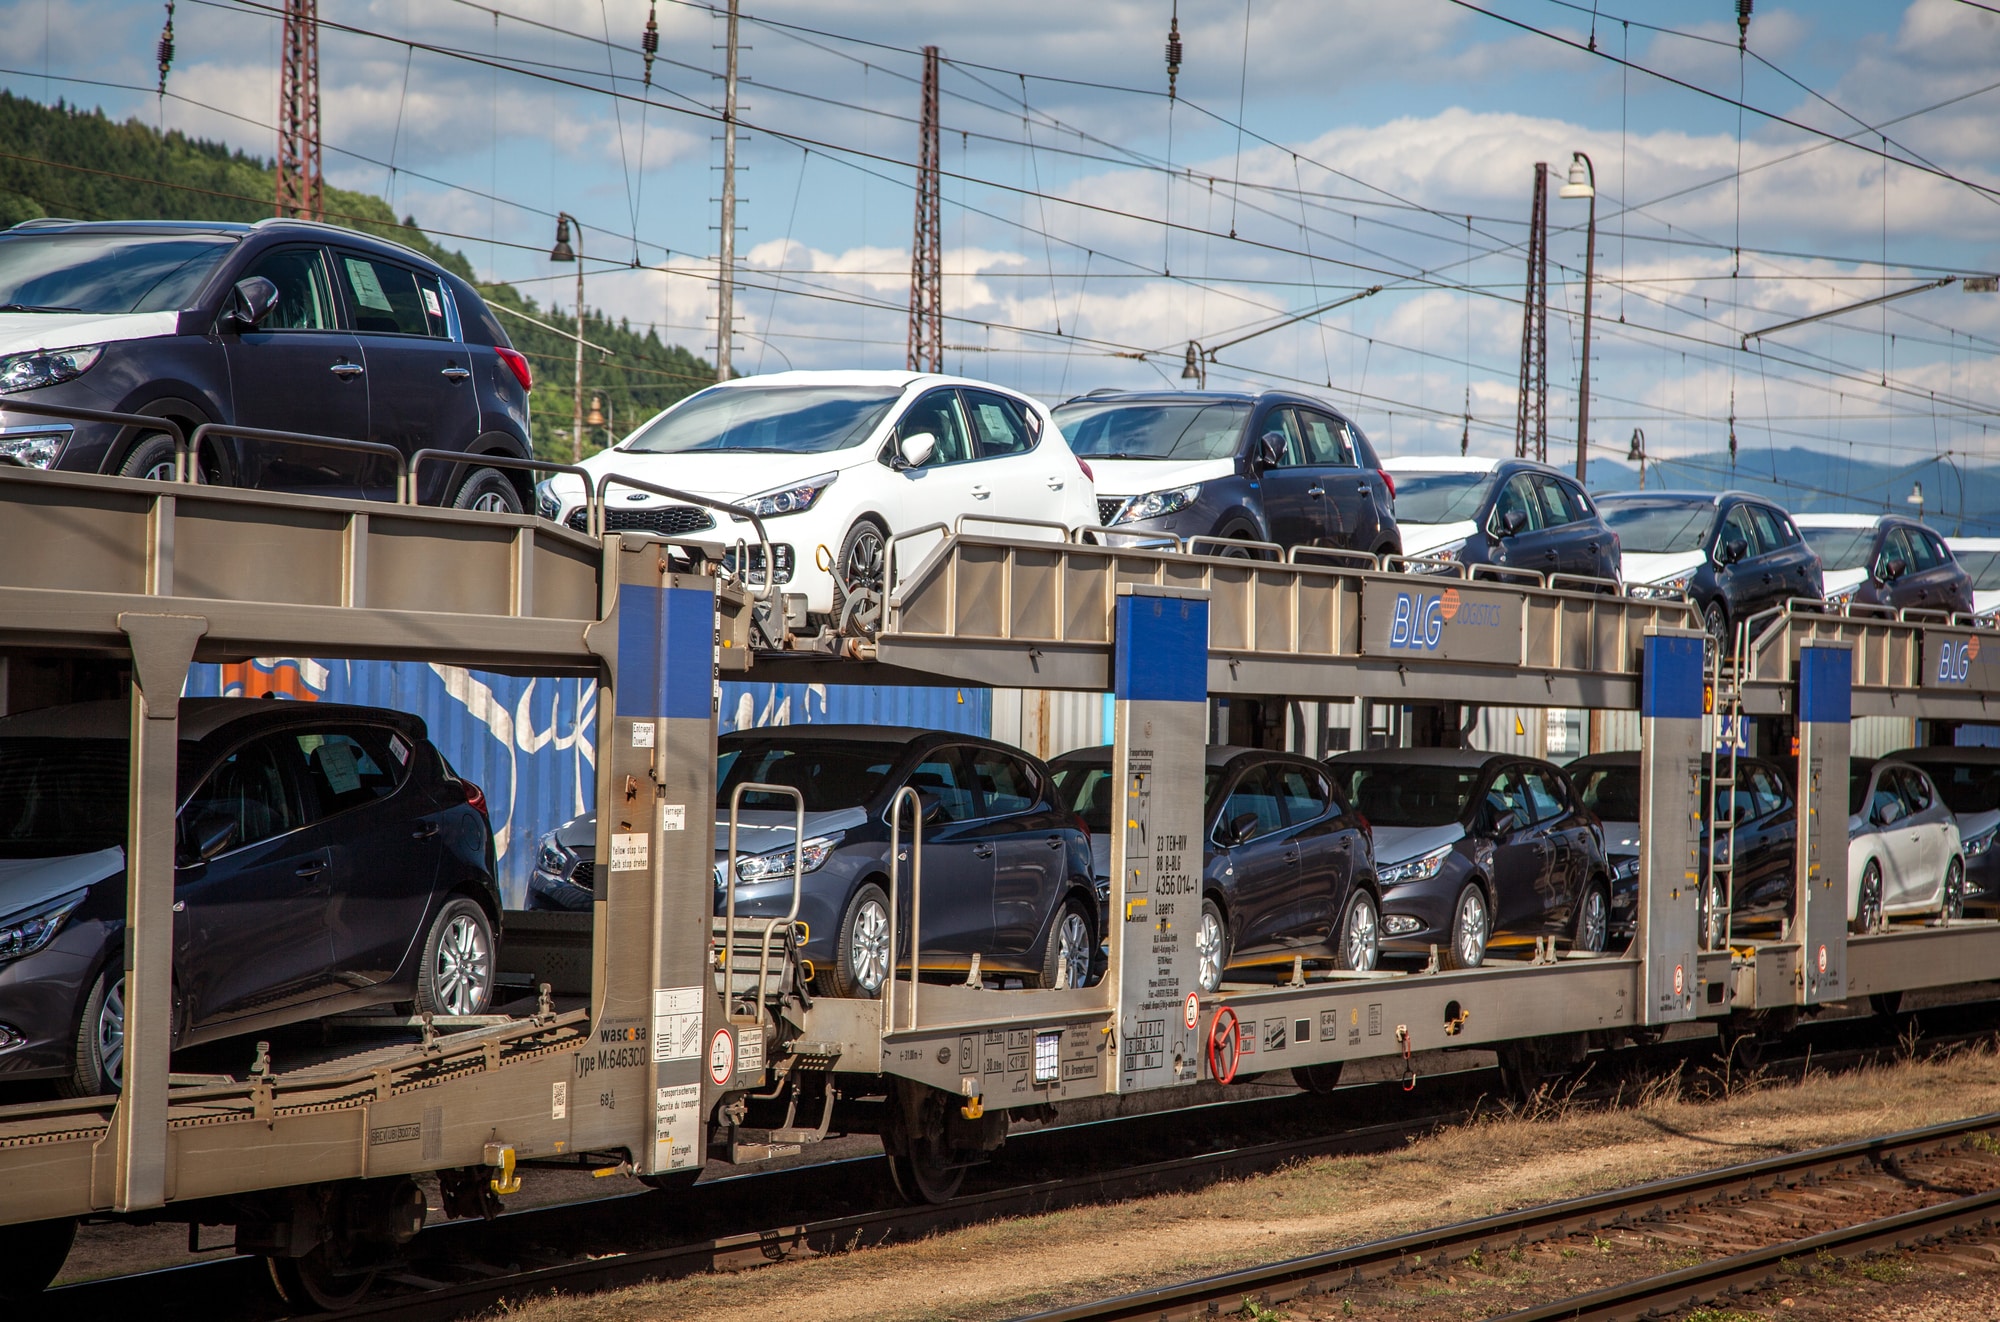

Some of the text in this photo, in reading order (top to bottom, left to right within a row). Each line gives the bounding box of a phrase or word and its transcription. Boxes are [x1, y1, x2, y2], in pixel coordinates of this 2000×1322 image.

[1390, 592, 1501, 651] BLG LOGISTICS
[1938, 639, 1970, 684] BLG
[1157, 835, 1164, 851] 23
[1156, 874, 1198, 895] 4356 014-1
[601, 1027, 646, 1042] wascosa
[1139, 1022, 1161, 1035] A B C
[963, 1047, 971, 1060] G1
[1129, 1041, 1133, 1053] S
[574, 1052, 595, 1078] Type
[600, 1093, 610, 1106] 68
[661, 1087, 697, 1098] Transportsicherung
